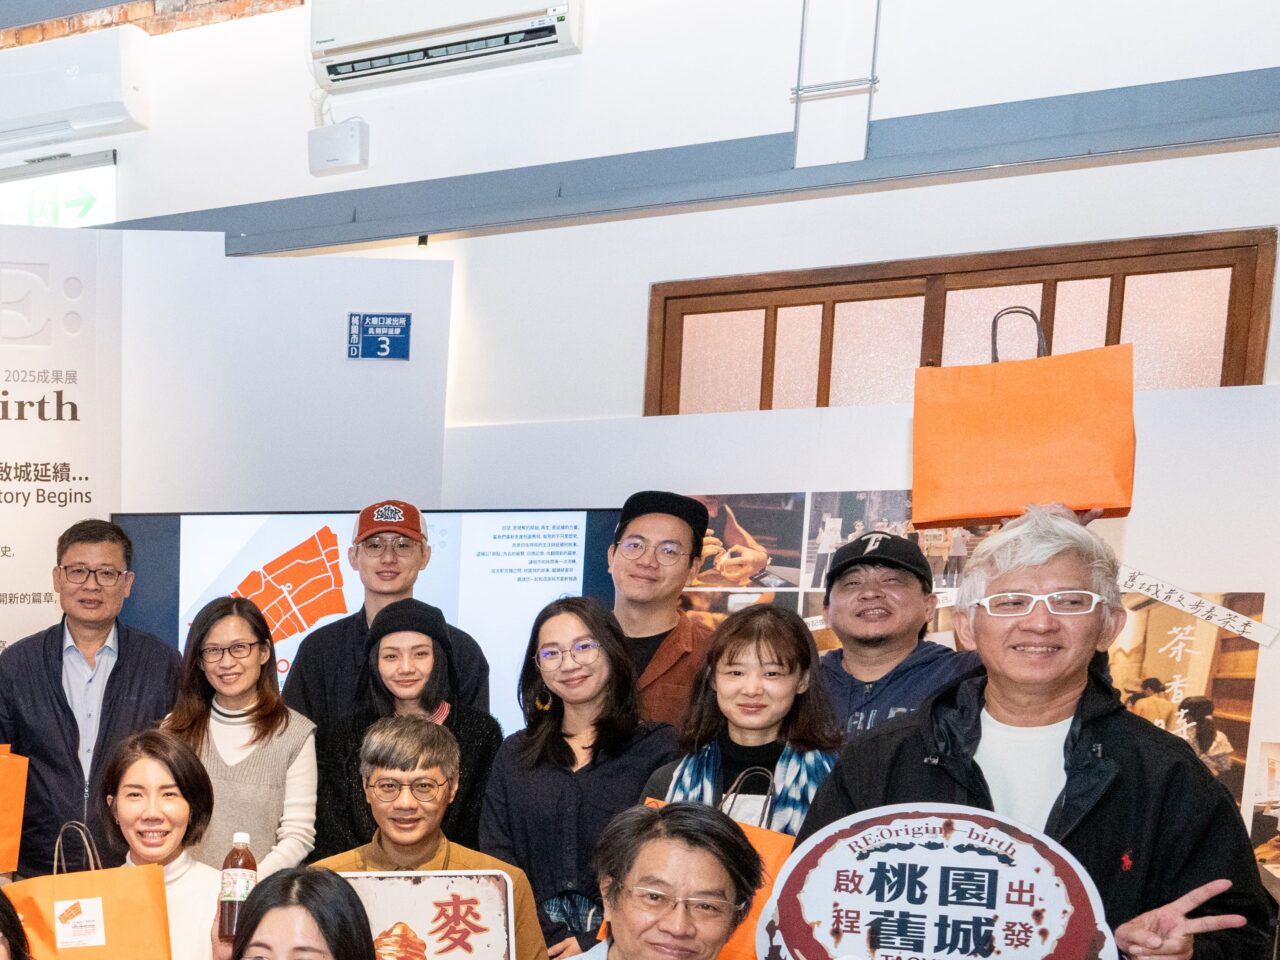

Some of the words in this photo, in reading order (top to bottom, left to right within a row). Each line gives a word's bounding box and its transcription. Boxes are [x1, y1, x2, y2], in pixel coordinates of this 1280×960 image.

[350, 347, 358, 356] D
[377, 336, 391, 357] 3
[4, 367, 78, 385] 2025成果展
[36, 487, 92, 508] Begins
[866, 861, 999, 910] 桃園
[864, 910, 996, 959] 舊城
